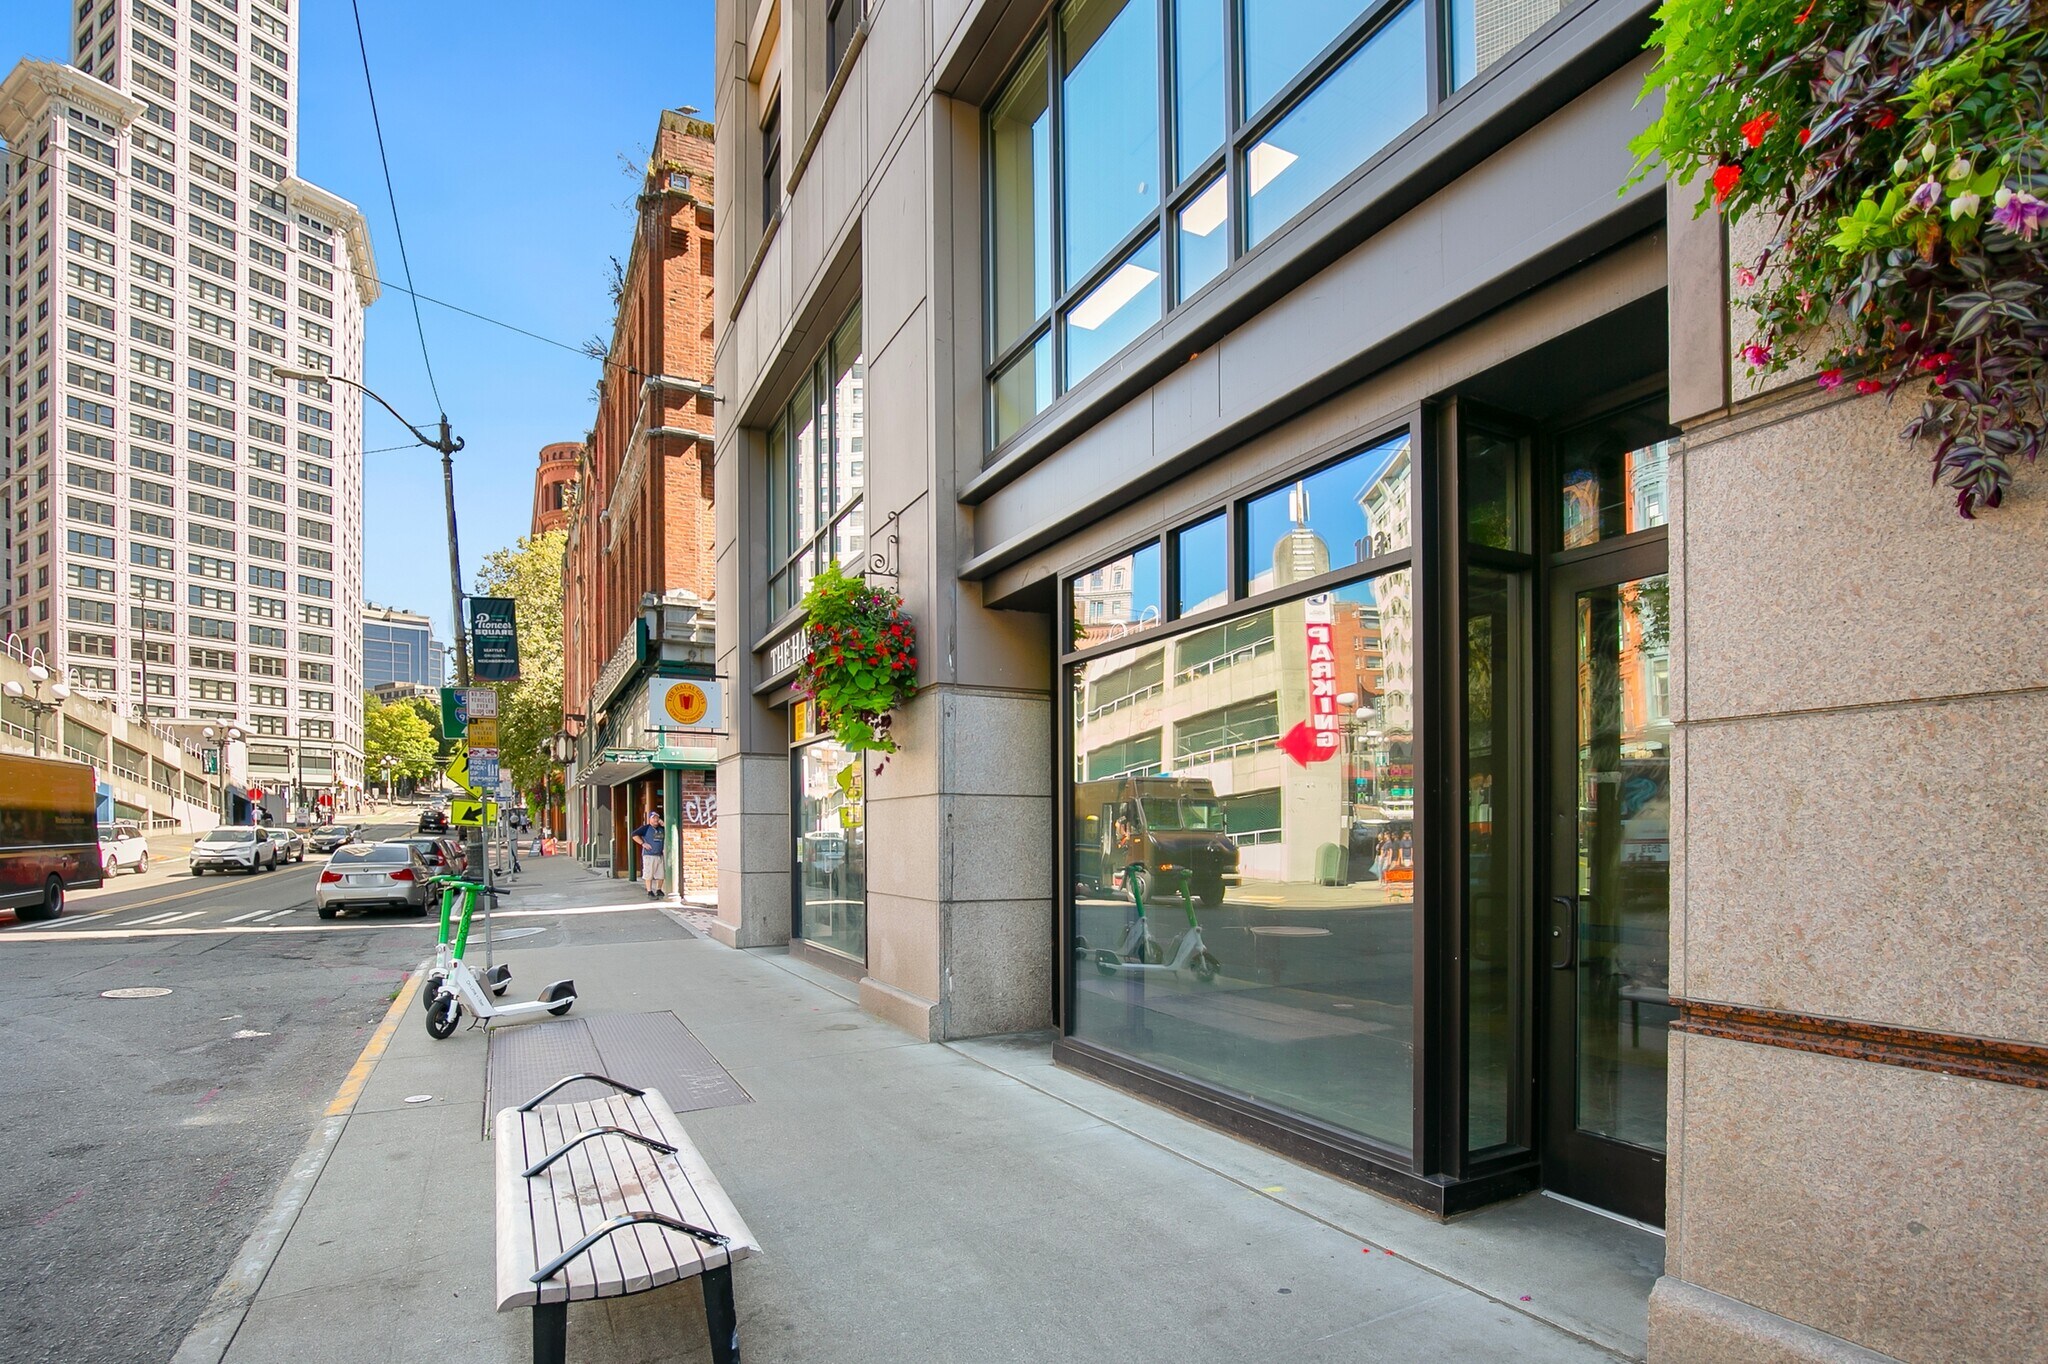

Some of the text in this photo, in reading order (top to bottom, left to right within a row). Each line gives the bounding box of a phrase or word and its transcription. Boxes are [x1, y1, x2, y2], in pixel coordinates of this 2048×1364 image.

[475, 612, 512, 629] Pioneer
[475, 628, 514, 636] SQUARE
[770, 638, 790, 676] THE
[667, 684, 706, 705] THE HALAL GUYS
